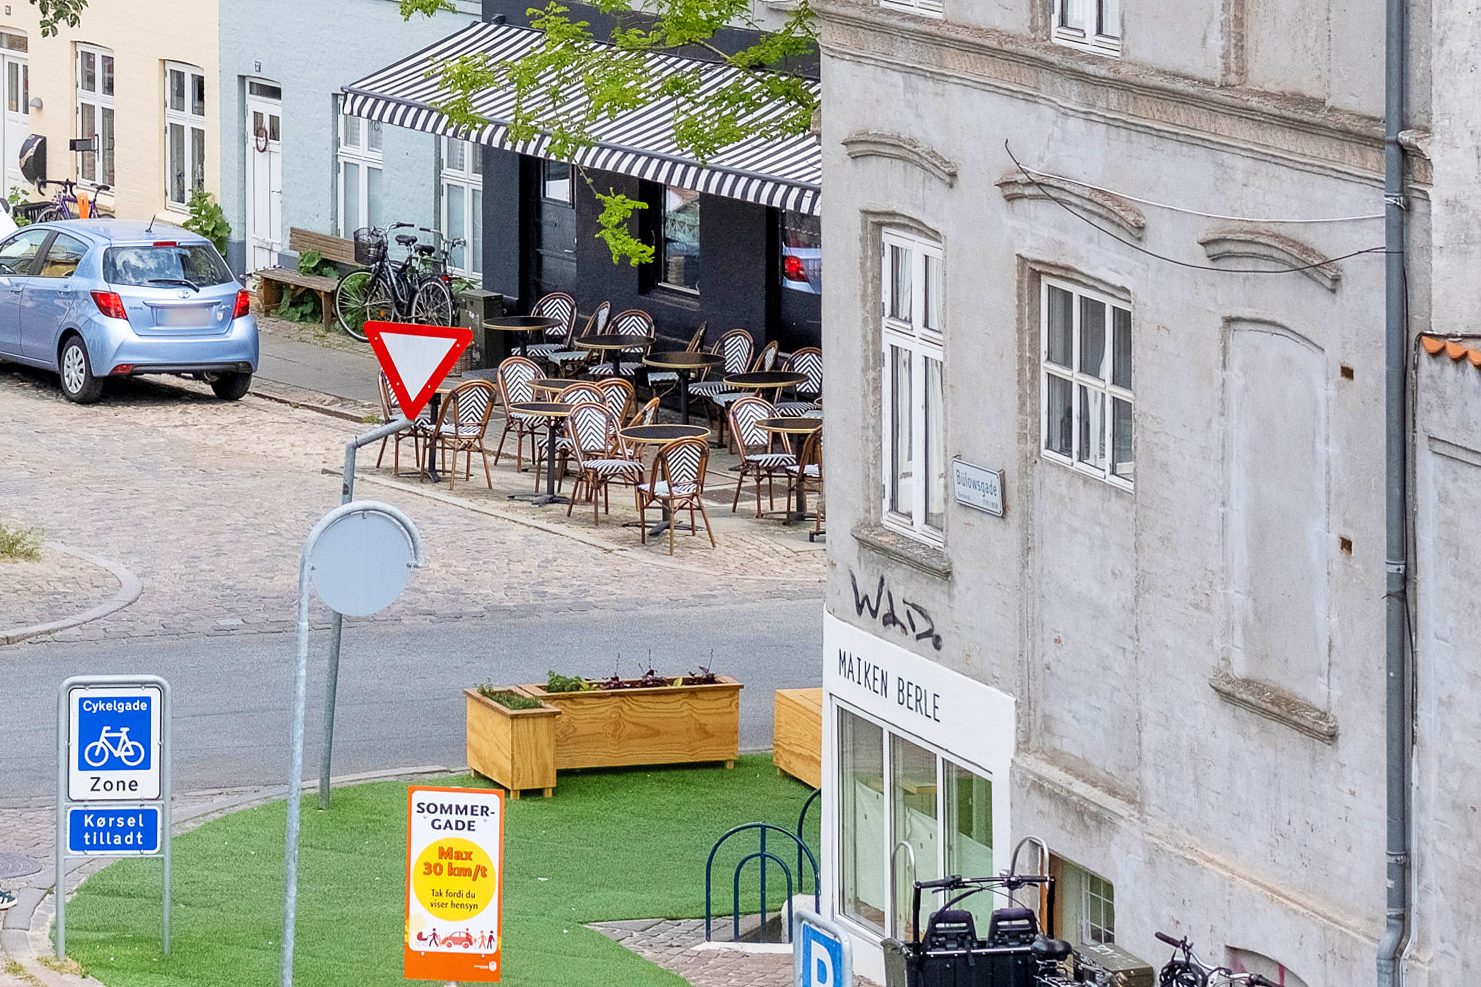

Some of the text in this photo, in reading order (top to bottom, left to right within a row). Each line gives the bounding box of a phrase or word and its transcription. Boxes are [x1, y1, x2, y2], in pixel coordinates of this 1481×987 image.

[955, 469, 998, 498] Bülowsgade
[838, 648, 941, 723] MAIKEN BERLE
[82, 699, 148, 714] Cykelgade
[89, 776, 139, 792] Zone
[416, 802, 496, 817] SOMMER-
[83, 813, 144, 828] Kørsel
[430, 818, 476, 832] GADE
[83, 831, 144, 845] tilladt
[437, 846, 473, 861] Max
[422, 862, 488, 882] 30 km/t
[431, 888, 476, 899] Tak fordi du
[430, 899, 479, 912] viser hensyn
